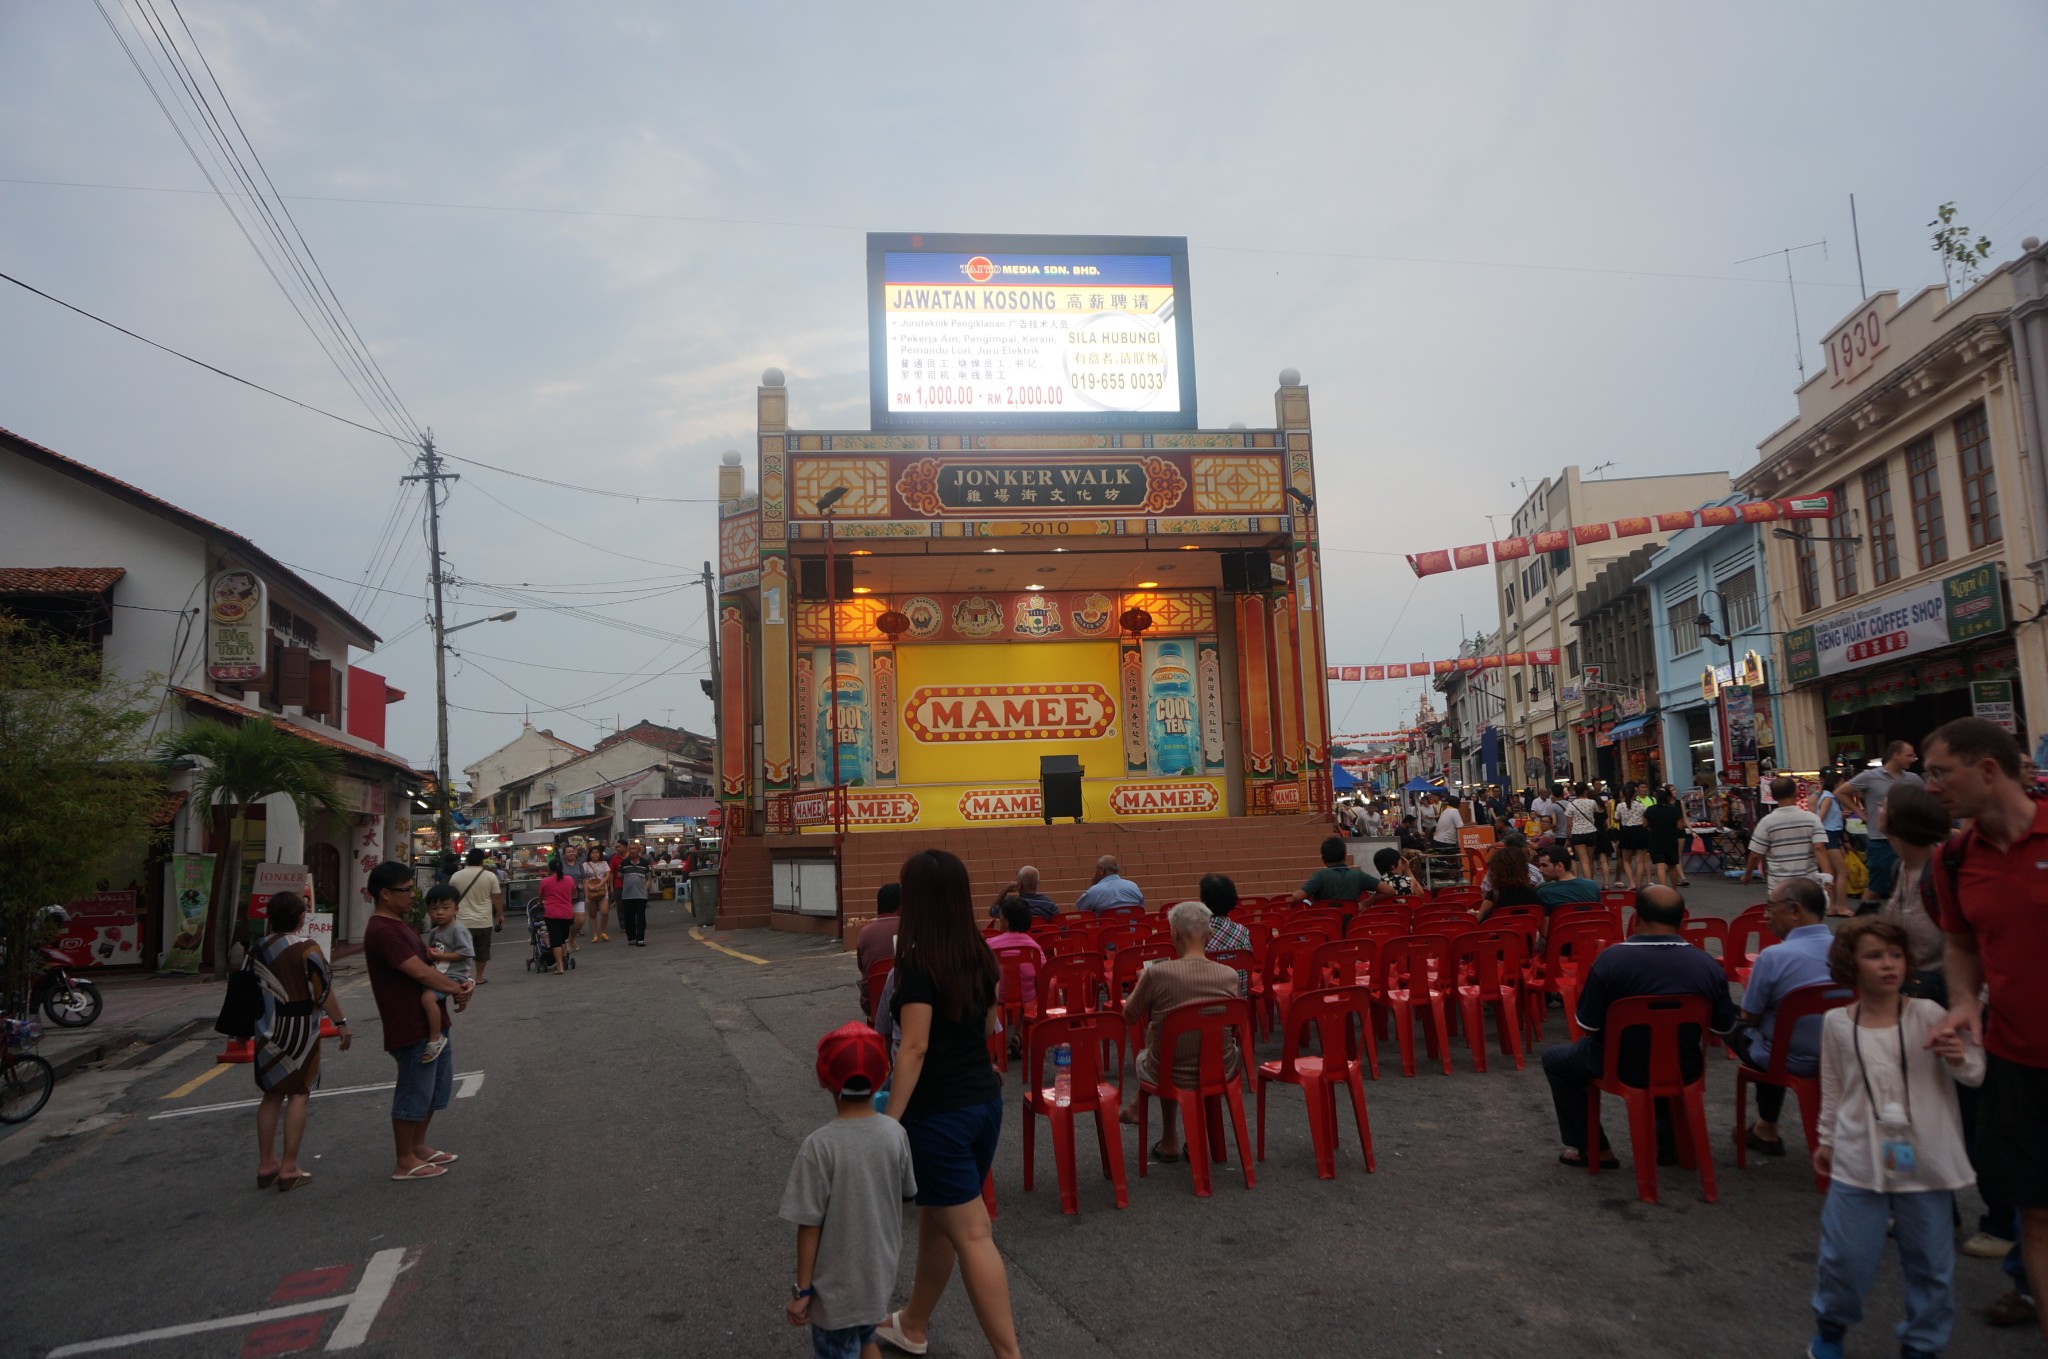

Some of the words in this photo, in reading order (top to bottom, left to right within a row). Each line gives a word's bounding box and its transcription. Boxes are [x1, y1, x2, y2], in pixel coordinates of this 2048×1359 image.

[1003, 265, 1040, 274] MEDIA
[1043, 266, 1070, 275] SDN.
[1073, 266, 1100, 275] BHD.
[893, 289, 976, 310] JAWATAN
[984, 290, 1056, 310] KOSONG
[1066, 293, 1149, 310] 高薪聘请
[900, 318, 948, 328] Juruteknik
[951, 319, 1005, 329] Pengiklanan
[900, 335, 937, 344] Pekerja
[1068, 332, 1096, 344] SILA
[1102, 332, 1160, 344] HUBUNGI
[1831, 310, 1880, 376] 1930
[900, 346, 948, 355] Pemandu
[977, 346, 999, 355] Juru
[1002, 346, 1039, 355] Elektrik
[1130, 373, 1163, 390] 0033
[897, 393, 910, 404] RM
[916, 385, 973, 409] 1,000.00
[988, 393, 1001, 404] RM
[1007, 385, 1063, 409] 2,000.00
[953, 469, 1053, 486] JONKER
[1060, 468, 1131, 485] WALK
[1020, 522, 1069, 535] 2010
[1816, 630, 1841, 652] HENG
[1842, 621, 1867, 644] HUAT
[1870, 607, 1909, 636] COFFEE
[1912, 597, 1943, 623] SHOP
[218, 629, 249, 642] Big
[215, 641, 255, 655] Tart
[931, 697, 1092, 729] MAMEE
[1155, 697, 1192, 721] COOL
[1165, 718, 1186, 734] TEA
[973, 796, 1041, 813] MAME
[1123, 790, 1206, 807] MAMEE
[1275, 790, 1297, 803] MAMEE
[796, 801, 821, 818] MAMEE
[260, 871, 304, 882] JONKER
